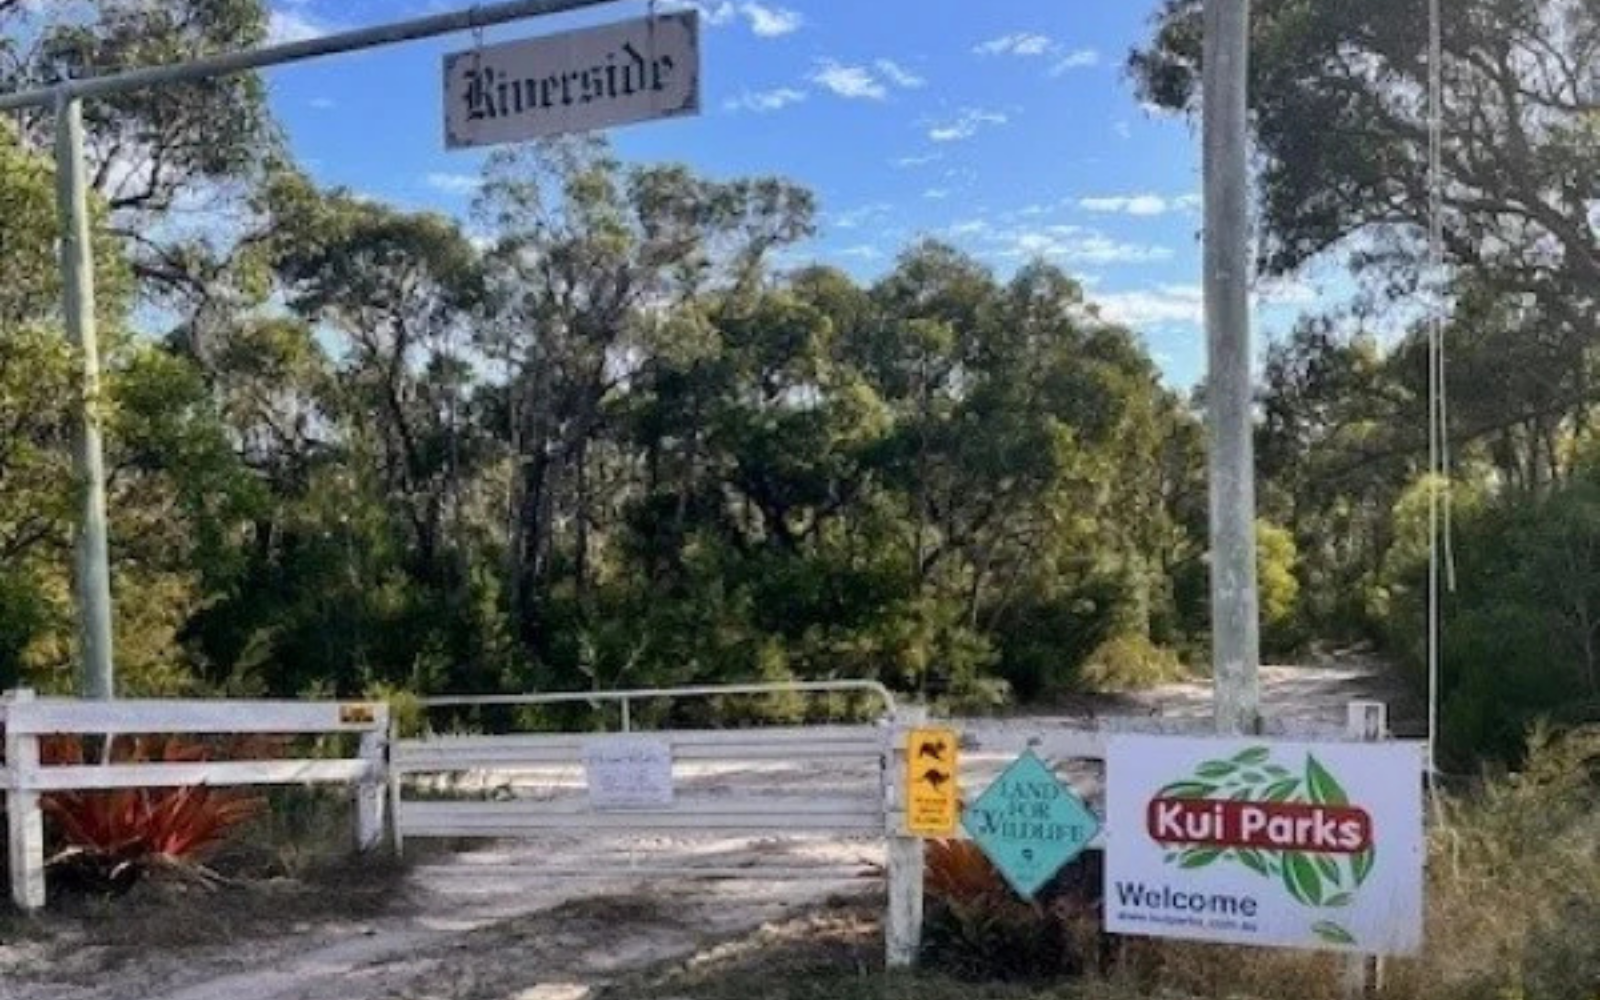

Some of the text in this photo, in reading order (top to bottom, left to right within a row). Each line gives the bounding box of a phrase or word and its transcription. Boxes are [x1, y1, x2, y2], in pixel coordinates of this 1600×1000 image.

[462, 43, 674, 120] Riverside
[1000, 780, 1059, 799] LAND
[973, 808, 1084, 841] WILDLIFE
[1007, 801, 1051, 818] FOR
[1155, 801, 1364, 848] Kui Parks
[1115, 881, 1258, 917] Welcome
